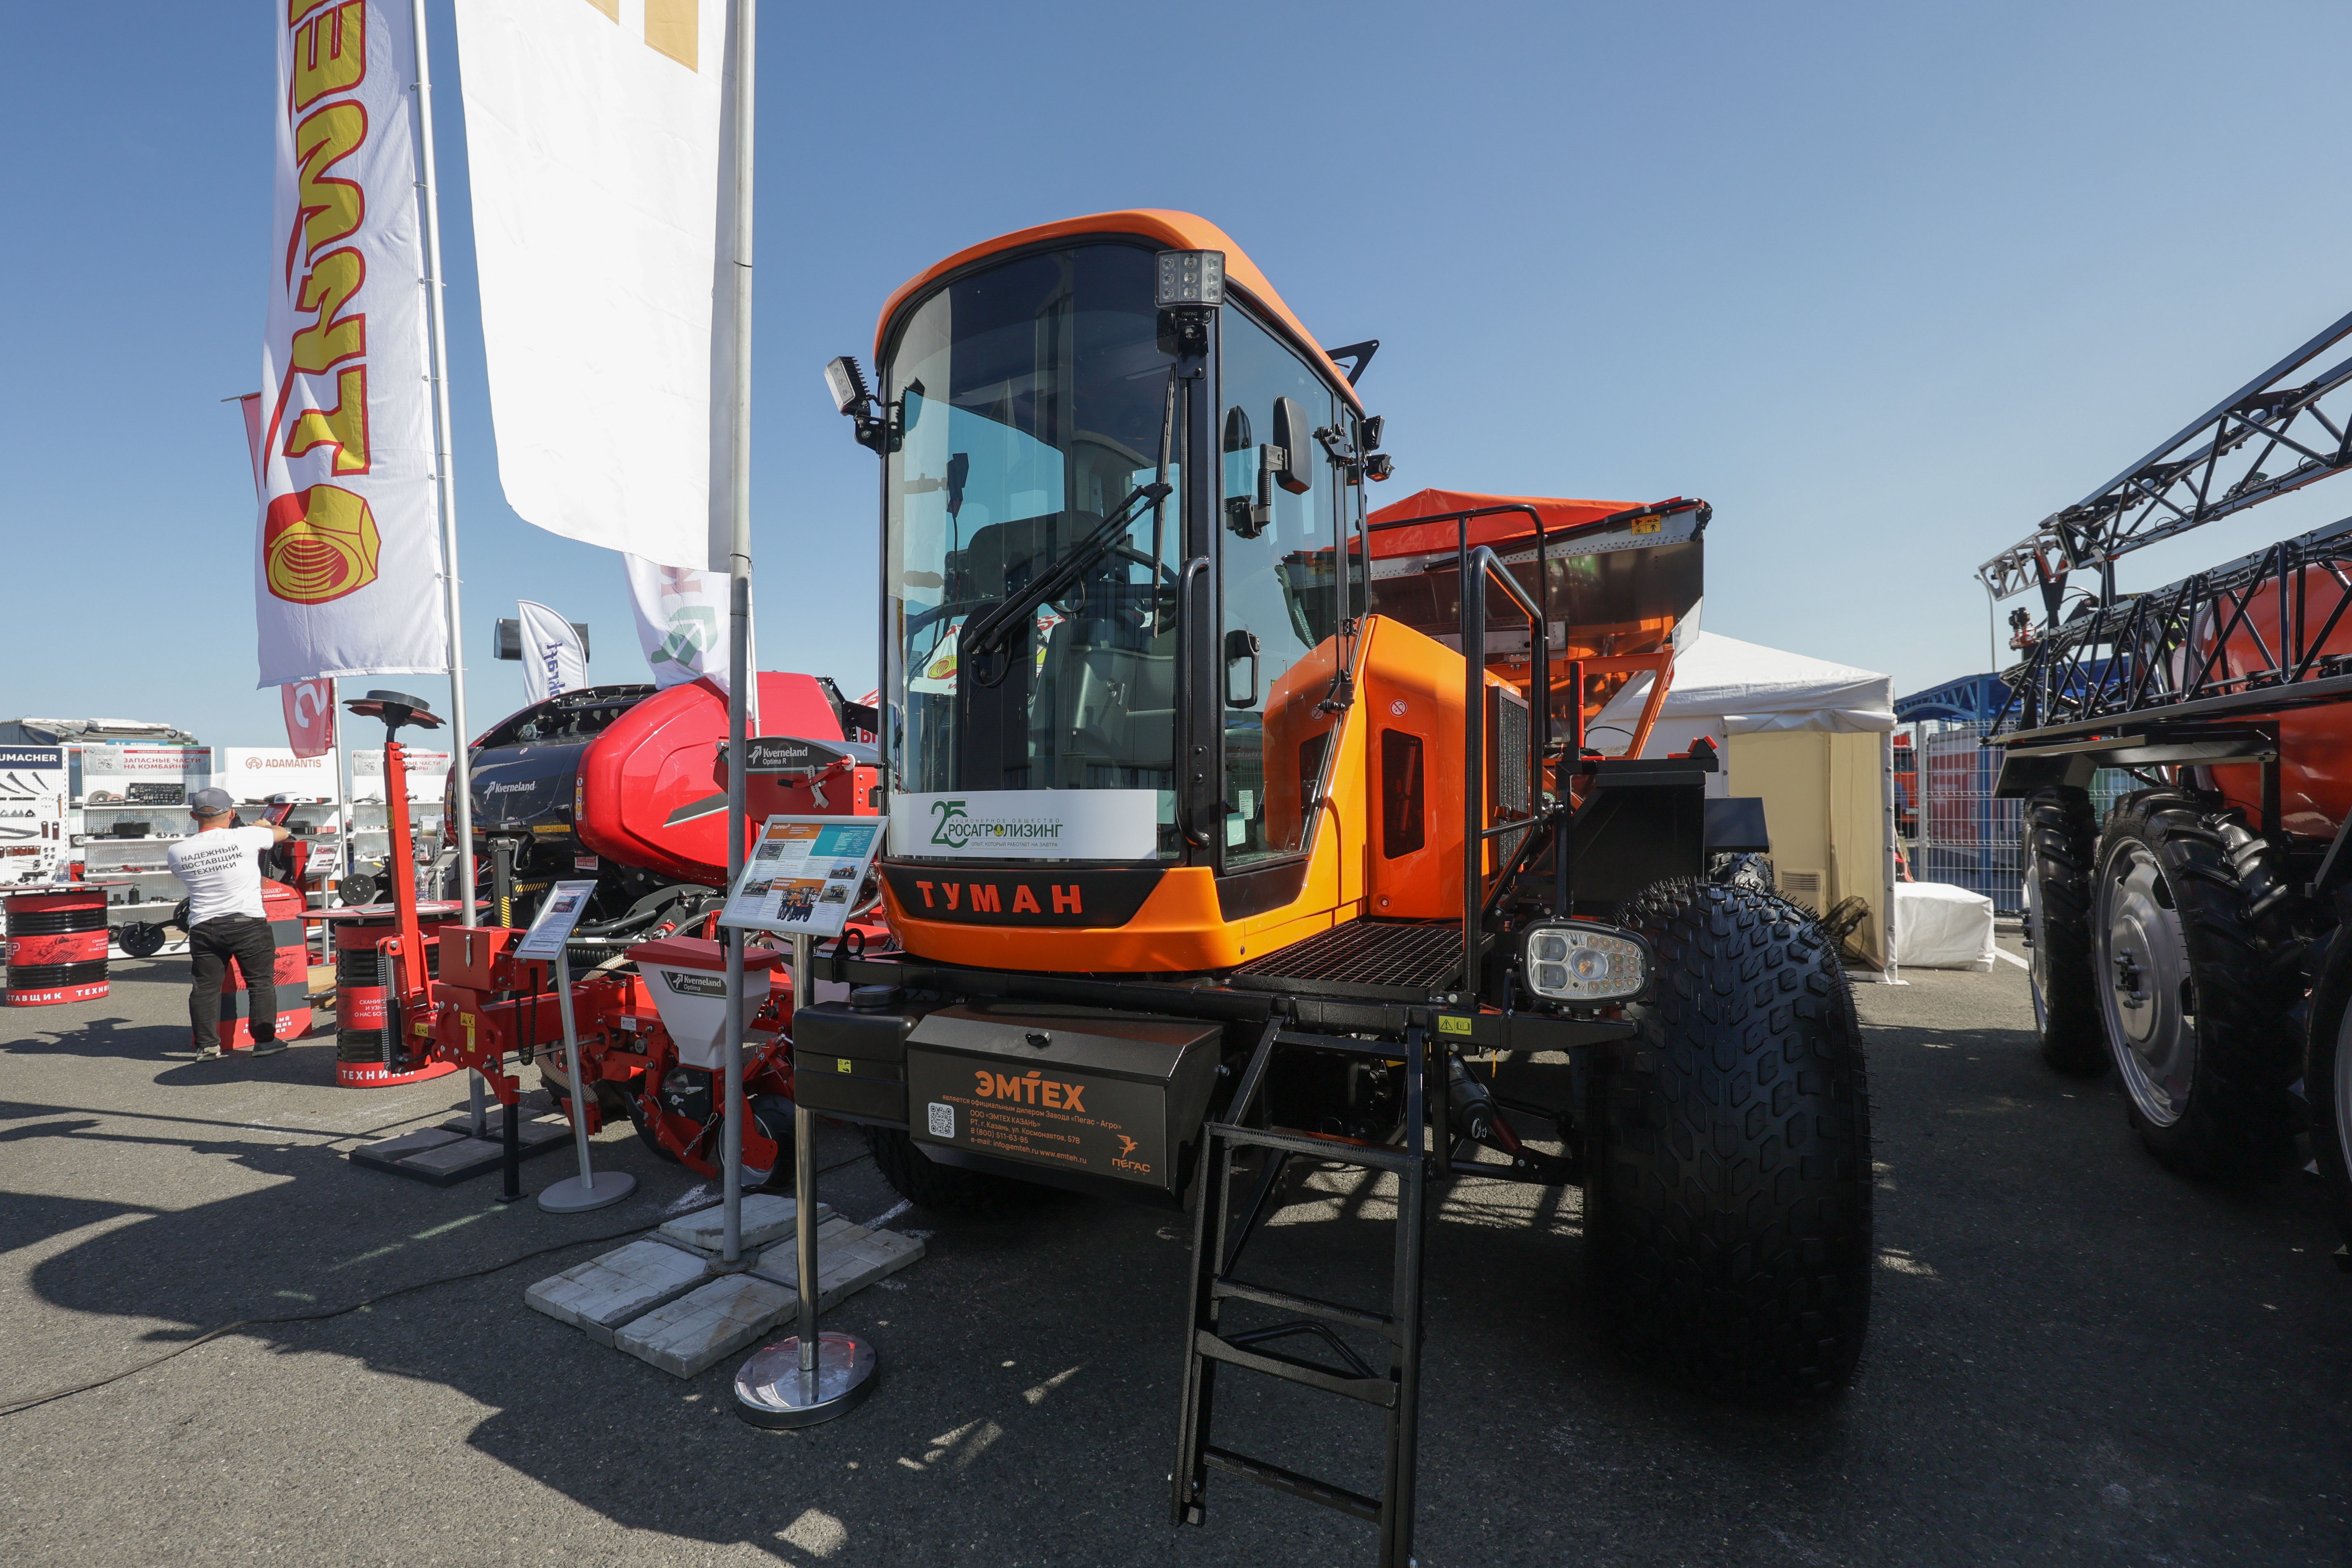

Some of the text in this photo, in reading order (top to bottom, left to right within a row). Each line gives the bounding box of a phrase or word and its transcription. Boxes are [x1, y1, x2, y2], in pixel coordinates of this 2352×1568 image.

[763, 747, 808, 757] Kverneland
[265, 759, 321, 768] ADAMANTIS
[495, 781, 535, 793] Kverneland
[948, 824, 1063, 838] РОСАГРОЛИЗИНГ
[181, 844, 239, 862] НАДЕЖНЫЙ
[181, 852, 242, 870] ПОСТАВЩИК
[192, 862, 237, 876] ТЕХНИКИ
[916, 881, 1083, 914] ТУМАН
[684, 975, 721, 987] Kverneland
[6, 992, 62, 1002] СТАВЩИК
[975, 1071, 1085, 1112] ЭМТЕХ
[942, 1095, 970, 1104] является
[971, 1100, 1015, 1112] официальным
[1016, 1107, 1044, 1117] дилером
[1046, 1111, 1069, 1121] Завода
[1071, 1115, 1095, 1125] «Пегас
[1100, 1120, 1122, 1130] Агро»
[970, 1110, 1041, 1127] ООО «ЭМТЕХ КАЗАНЬ»
[970, 1119, 980, 1127] РТ,
[986, 1123, 1011, 1132] Казань,
[1022, 1128, 1066, 1142] Космонавтов,
[976, 1128, 995, 1138] (800)
[996, 1133, 1029, 1144] 511-63-95
[971, 1137, 1087, 1164] e-mail: info@emteh.ru www.emteh.ru
[1112, 1158, 1150, 1173] ПЕГАС
